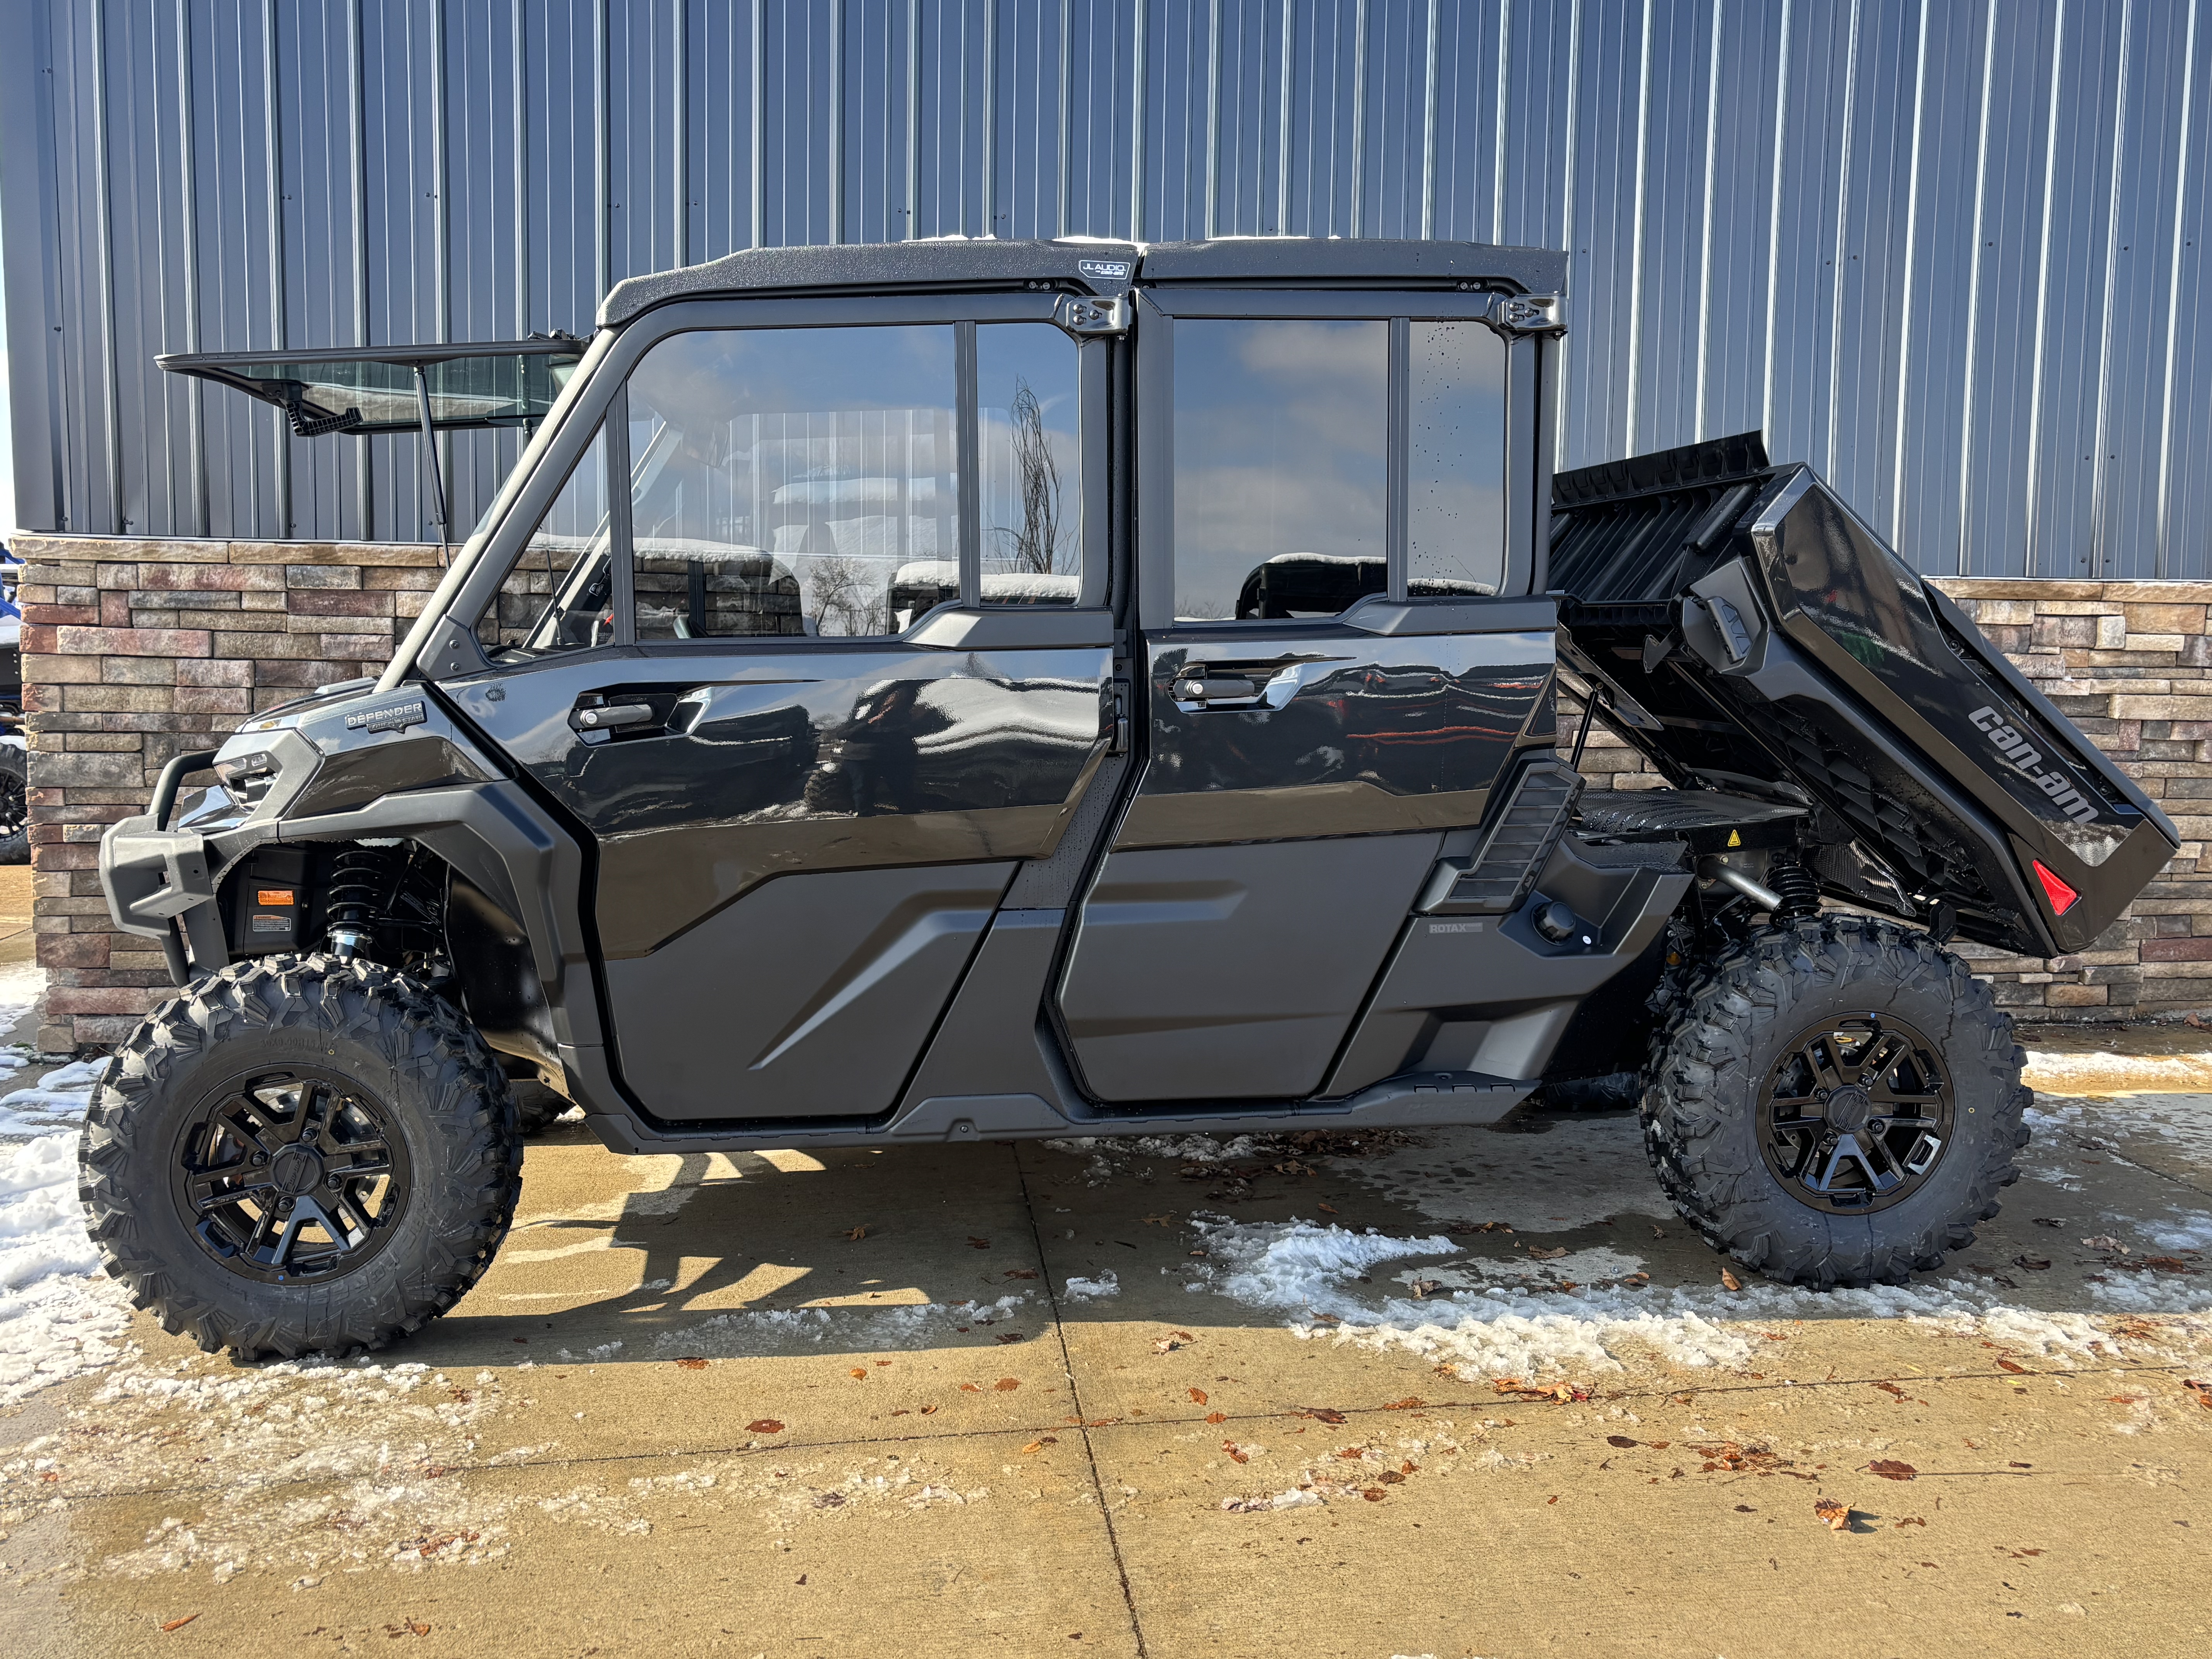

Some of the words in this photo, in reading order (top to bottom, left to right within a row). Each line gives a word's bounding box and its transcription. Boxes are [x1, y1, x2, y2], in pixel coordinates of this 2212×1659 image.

[347, 702, 421, 726] DEFENDER
[403, 714, 423, 722] STAR
[1968, 706, 2099, 824] can-am
[1430, 924, 1466, 933] ROTAX
